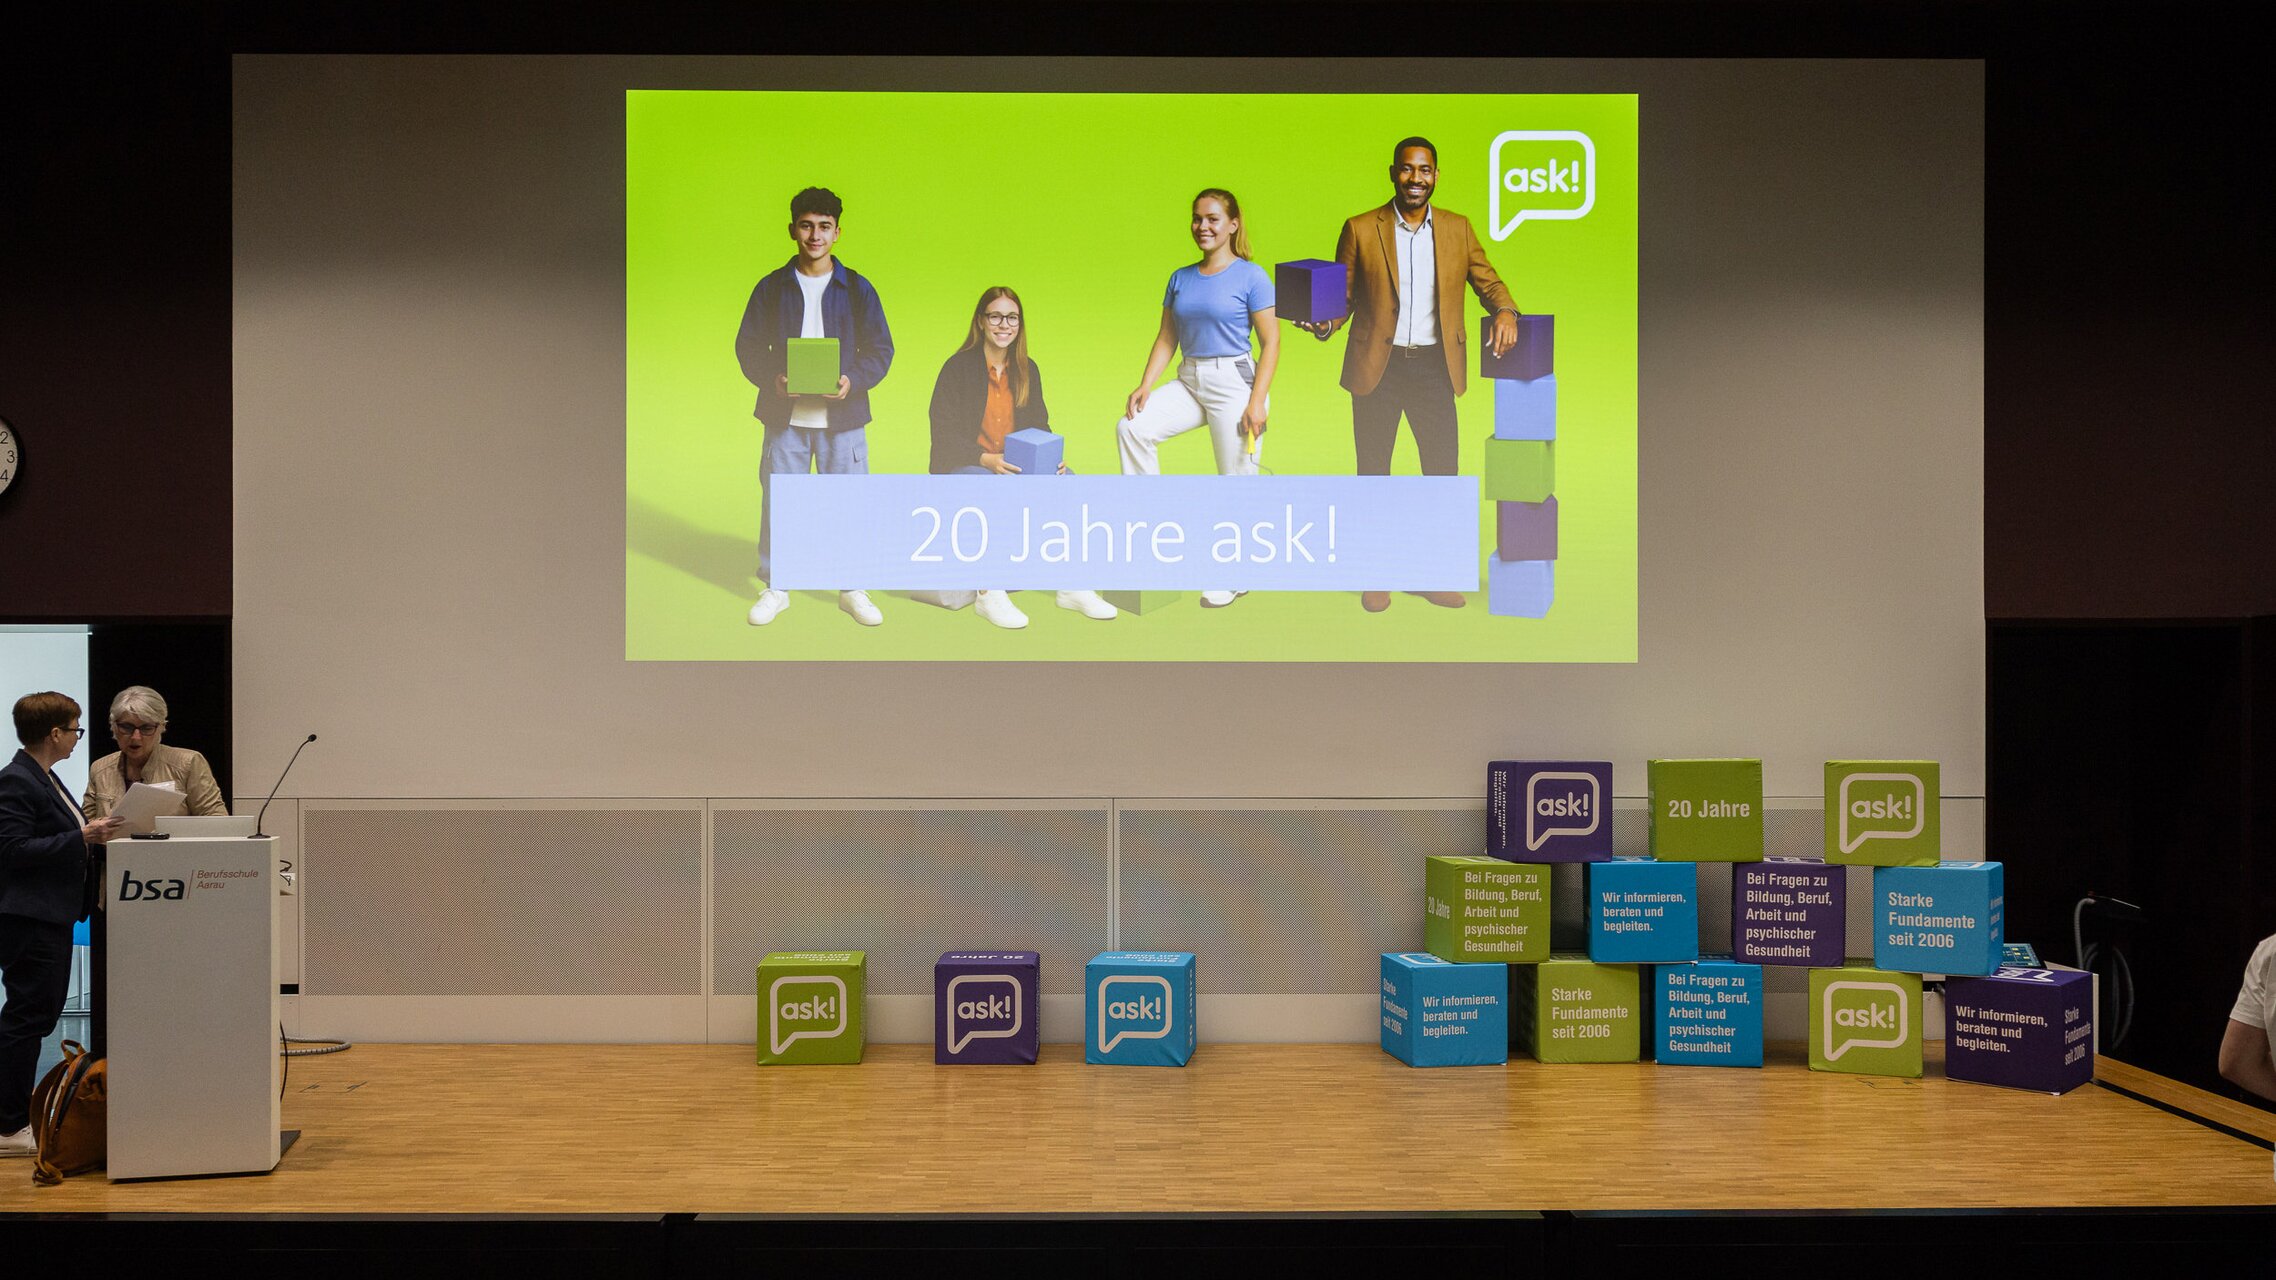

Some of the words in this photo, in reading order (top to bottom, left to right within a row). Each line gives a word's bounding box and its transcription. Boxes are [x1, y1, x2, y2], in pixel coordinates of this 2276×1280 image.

[1504, 158, 1579, 193] ask!
[0, 431, 8, 444] 2
[7, 450, 15, 464] 3
[0, 470, 8, 482] 4
[910, 506, 988, 563] 20
[1010, 504, 1185, 564] Jahre
[1212, 504, 1336, 564] ask!
[1537, 792, 1588, 816] ask!
[1669, 800, 1691, 818] 20
[1699, 800, 1749, 818] Jahre
[1851, 794, 1911, 819] ask!
[197, 869, 258, 879] Berufsschule
[1465, 872, 1481, 883] Bei
[1486, 872, 1521, 886] Fragen
[1526, 874, 1537, 884] zu
[1748, 873, 1764, 884] Bei
[1770, 874, 1810, 888] Fragen
[1814, 876, 1827, 886] zu
[119, 870, 184, 900] bsa
[197, 881, 224, 889] Aarau
[1465, 889, 1508, 903] Bildung,
[1512, 890, 1542, 902] Beruf,
[1603, 892, 1620, 902] Wir
[1624, 892, 1686, 903] informieren,
[1747, 891, 1794, 906] Bildung,
[1798, 892, 1832, 906] Beruf,
[1889, 892, 1933, 907] Starke
[1428, 896, 1434, 914] 20
[1436, 898, 1450, 920] Jahre
[1464, 906, 1497, 918] Arbeit
[1503, 906, 1519, 918] und
[1604, 907, 1641, 917] beraten
[1645, 907, 1663, 917] und
[1746, 908, 1781, 921] Arbeit
[1785, 910, 1806, 922] und
[1604, 921, 1653, 933] begleiten.
[1889, 912, 1974, 928] Fundamente
[1465, 924, 1528, 937] psychischer
[1746, 927, 1816, 941] psychischer
[1465, 940, 1523, 952] Gesundheit
[1889, 932, 1914, 946] seit
[1918, 933, 1954, 948] 2006
[1746, 944, 1810, 958] Gesundheit
[1384, 978, 1396, 996] Starke
[1669, 974, 1685, 984] Bei
[1690, 975, 1728, 988] Fragen
[1732, 977, 1744, 986] zu
[1423, 997, 1440, 1007] Wir
[1442, 995, 1498, 1006] informieren,
[1552, 988, 1592, 1001] Starke
[1669, 991, 1713, 1005] Bildung,
[1718, 992, 1749, 1004] Beruf,
[781, 996, 835, 1019] ask!
[958, 994, 1010, 1019] ask!
[1108, 996, 1160, 1020] ask!
[1384, 996, 1408, 1020] Fundamente
[1552, 1006, 1628, 1020] Fundamente
[1669, 1007, 1702, 1018] Arbeit
[1706, 1008, 1726, 1019] und
[1424, 1010, 1457, 1021] beraten
[1460, 1009, 1478, 1020] und
[1836, 1003, 1894, 1028] ask!
[1956, 1006, 1975, 1017] Wir
[1978, 1008, 2048, 1029] informieren,
[2065, 1006, 2079, 1024] Starke
[1424, 1025, 1468, 1038] begleiten.
[1553, 1026, 1574, 1038] seit
[1579, 1025, 1610, 1038] 2006
[1670, 1024, 1735, 1037] psychischer
[1956, 1019, 1998, 1037] beraten
[2002, 1027, 2022, 1038] und
[2065, 1022, 2091, 1044] Fundamente
[1670, 1040, 1731, 1052] Gesundheit
[1956, 1035, 2010, 1052] begleiten.
